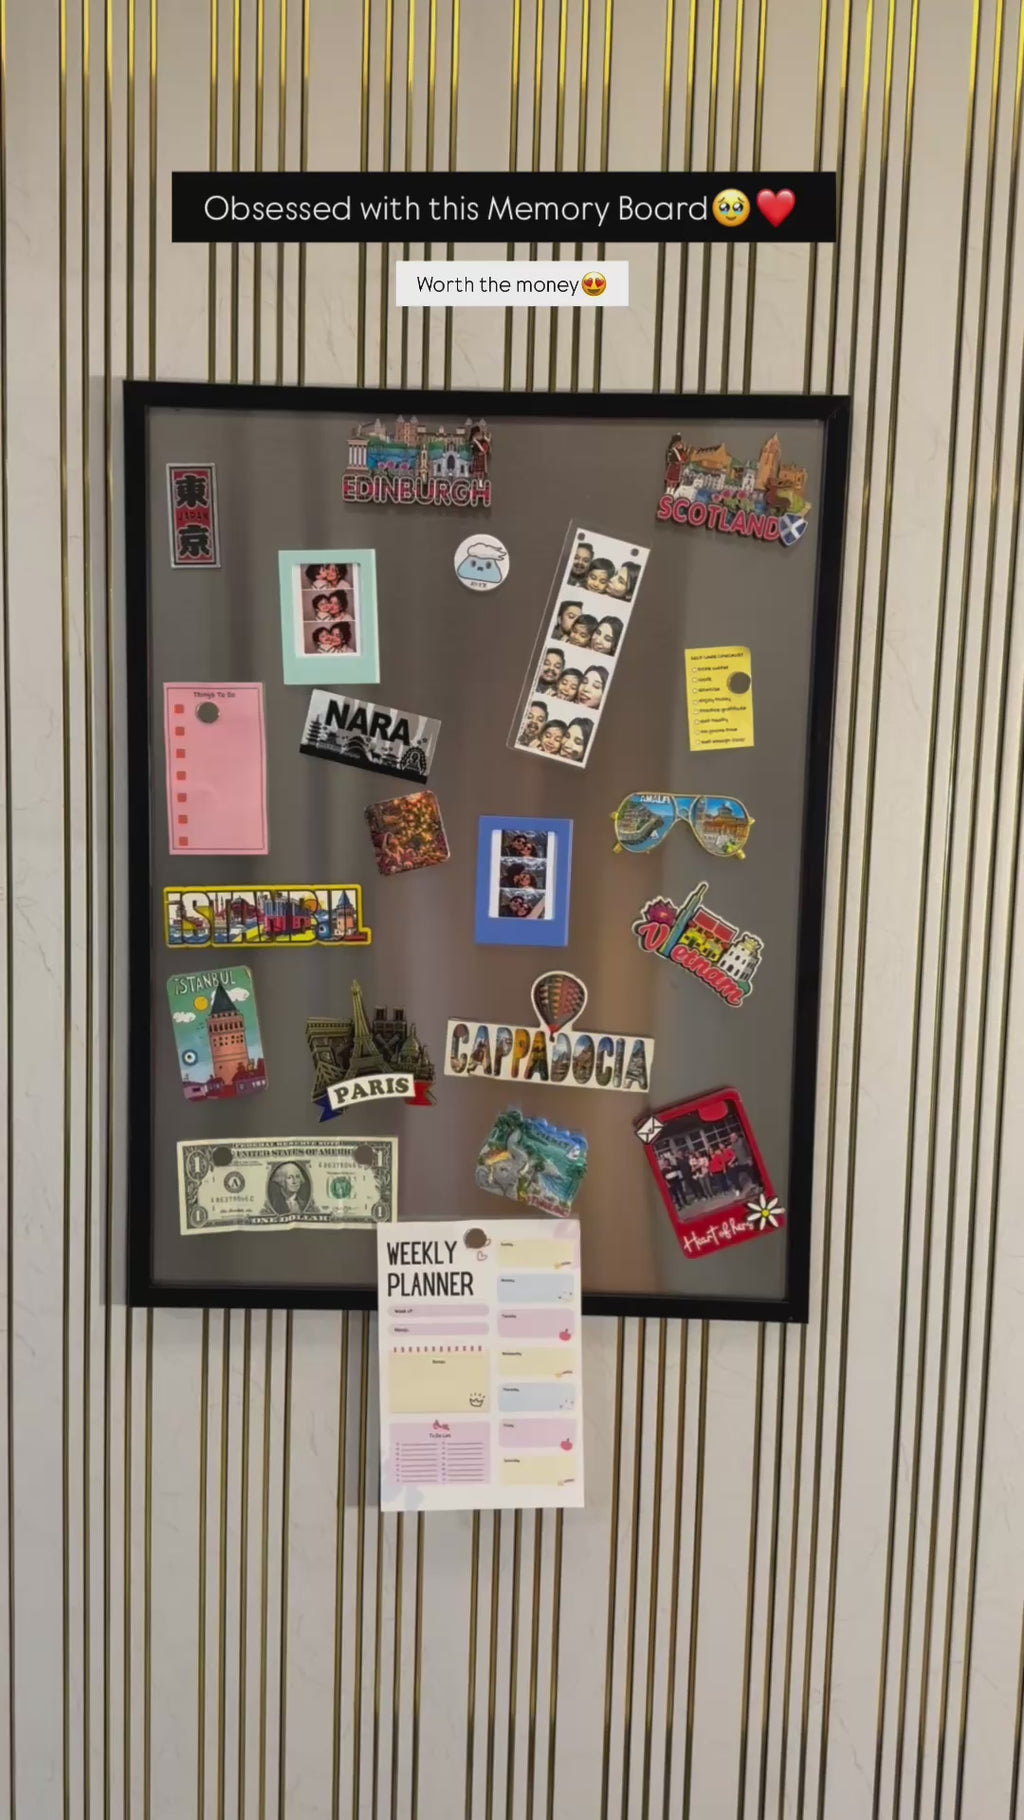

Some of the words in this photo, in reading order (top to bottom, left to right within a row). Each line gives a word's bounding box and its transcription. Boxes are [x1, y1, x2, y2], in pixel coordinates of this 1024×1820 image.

[342, 474, 491, 507] EDINBURGH
[657, 495, 781, 541] SCOTLAND
[324, 699, 411, 746] NARA
[450, 1023, 648, 1090] CAPPADOCIA
[334, 1078, 410, 1104] PARIS
[272, 1149, 304, 1157] STATES
[280, 1214, 331, 1223] DOLLAR
[684, 1226, 719, 1253] Heart
[718, 1222, 732, 1239] of
[386, 1240, 458, 1266] WEEKLY
[387, 1271, 474, 1297] PLANNER
